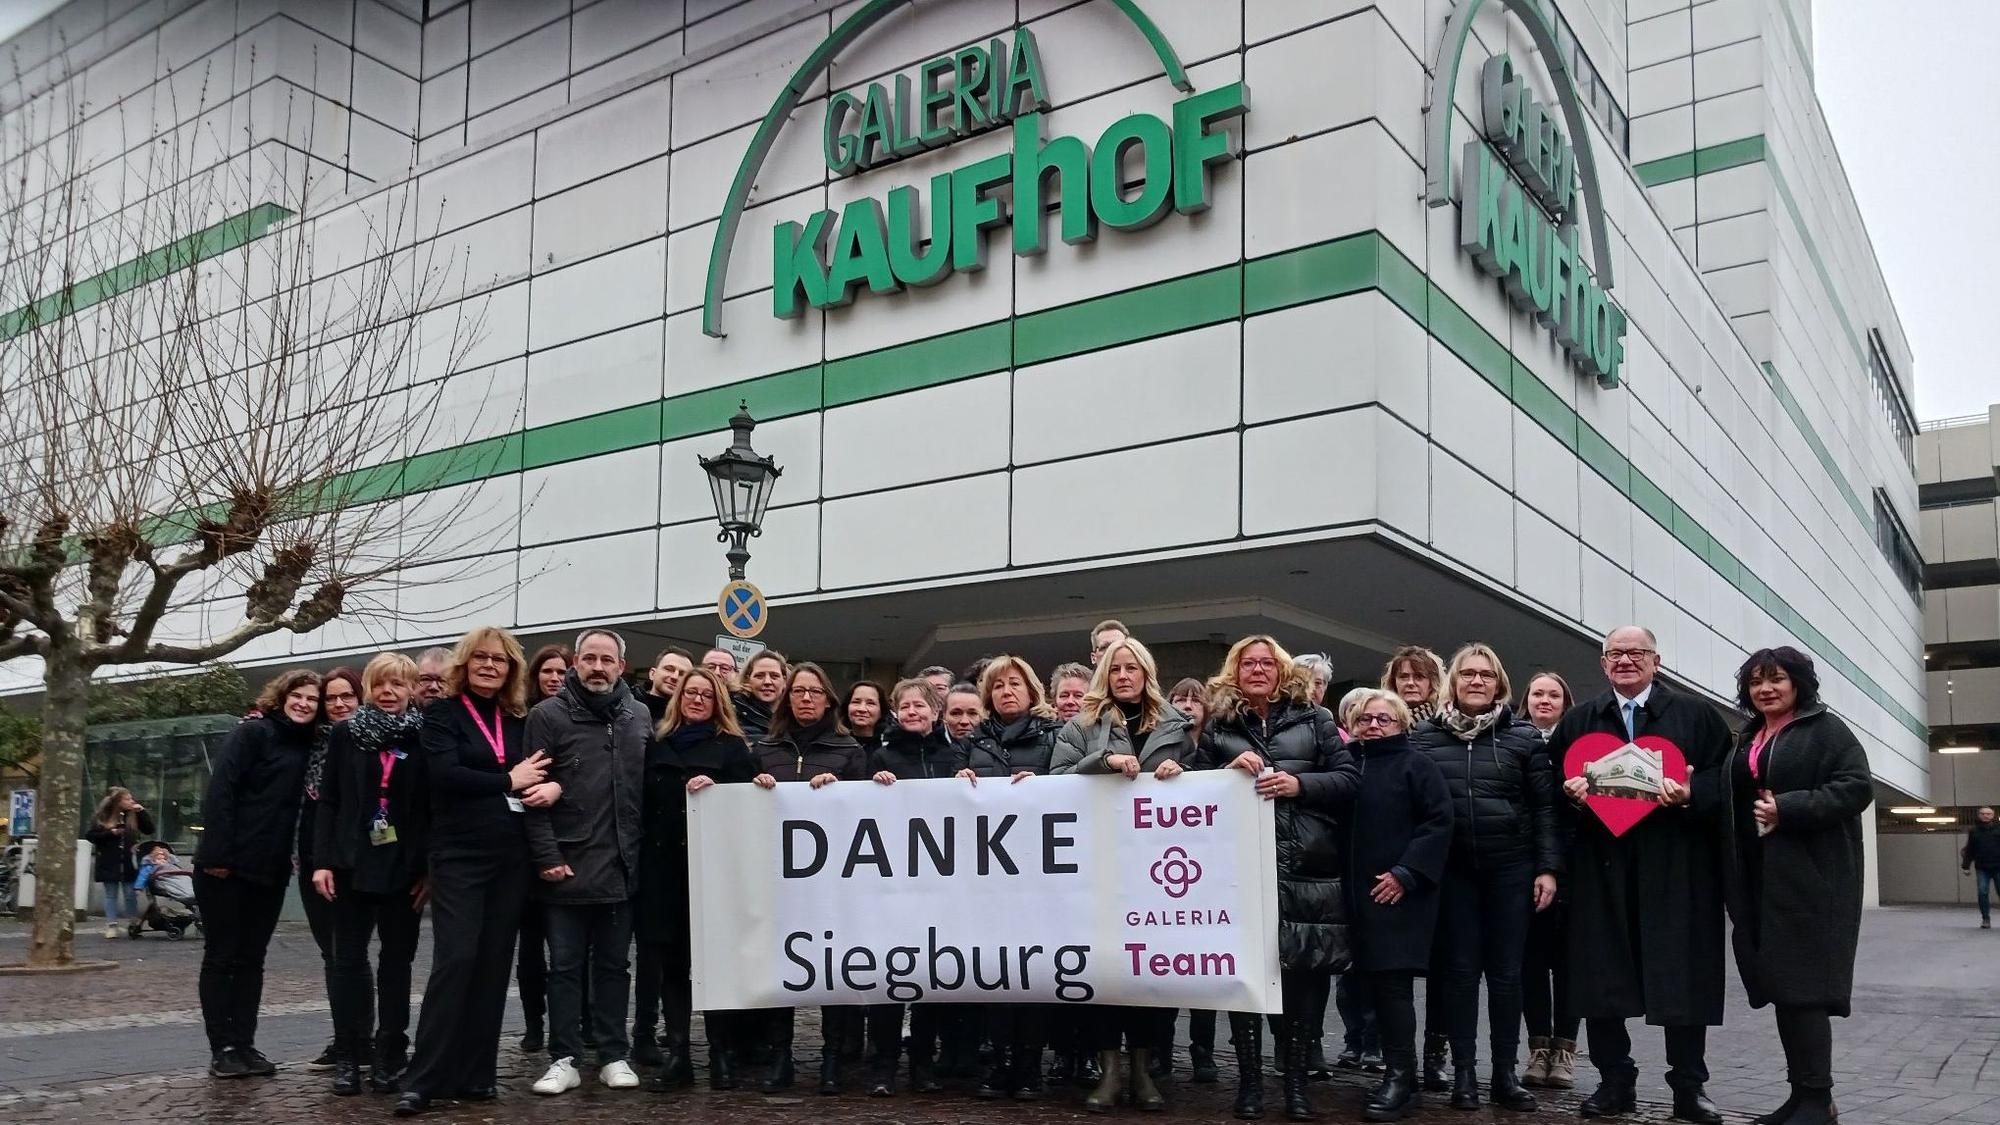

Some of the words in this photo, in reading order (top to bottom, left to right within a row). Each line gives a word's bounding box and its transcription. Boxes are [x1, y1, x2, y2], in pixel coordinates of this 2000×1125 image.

[824, 26, 1051, 176] GALERIA
[1133, 797, 1218, 829] Euer
[782, 813, 1078, 878] DANKE
[1126, 909, 1231, 927] GALERIA
[783, 926, 1095, 1002] Siegburg
[1125, 943, 1236, 976] Team
